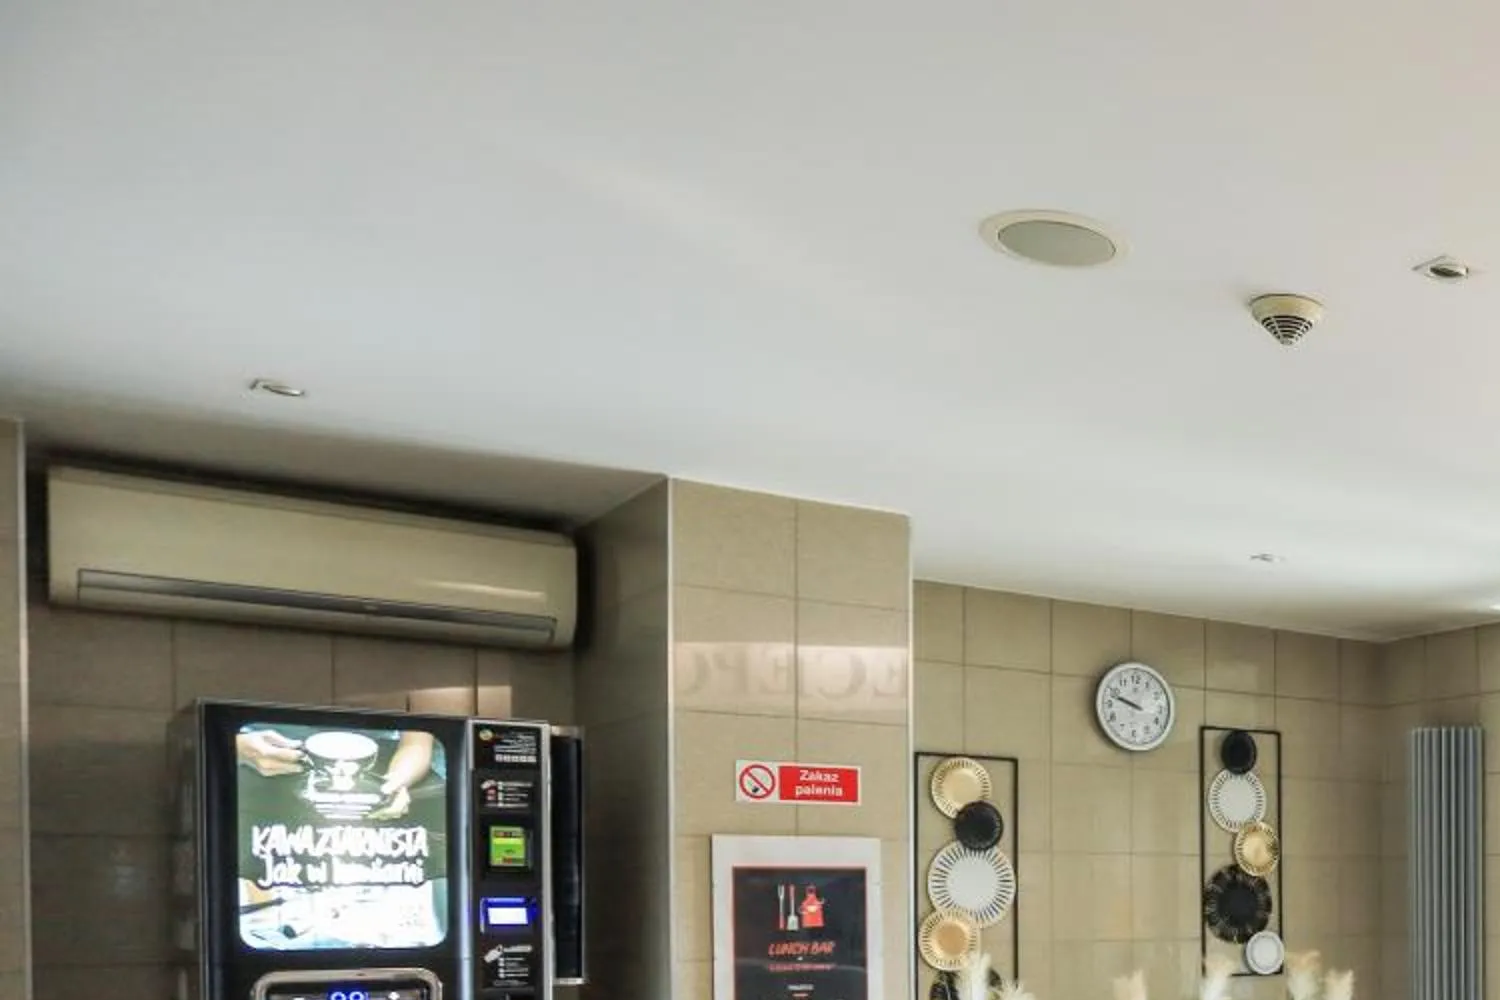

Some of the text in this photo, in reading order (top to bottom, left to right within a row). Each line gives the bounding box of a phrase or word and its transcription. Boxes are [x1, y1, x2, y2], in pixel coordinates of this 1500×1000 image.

[799, 769, 839, 783] Zakaz
[795, 784, 843, 798] palenia
[257, 856, 303, 887] Jak
[767, 940, 836, 956] LUNCH BAR
